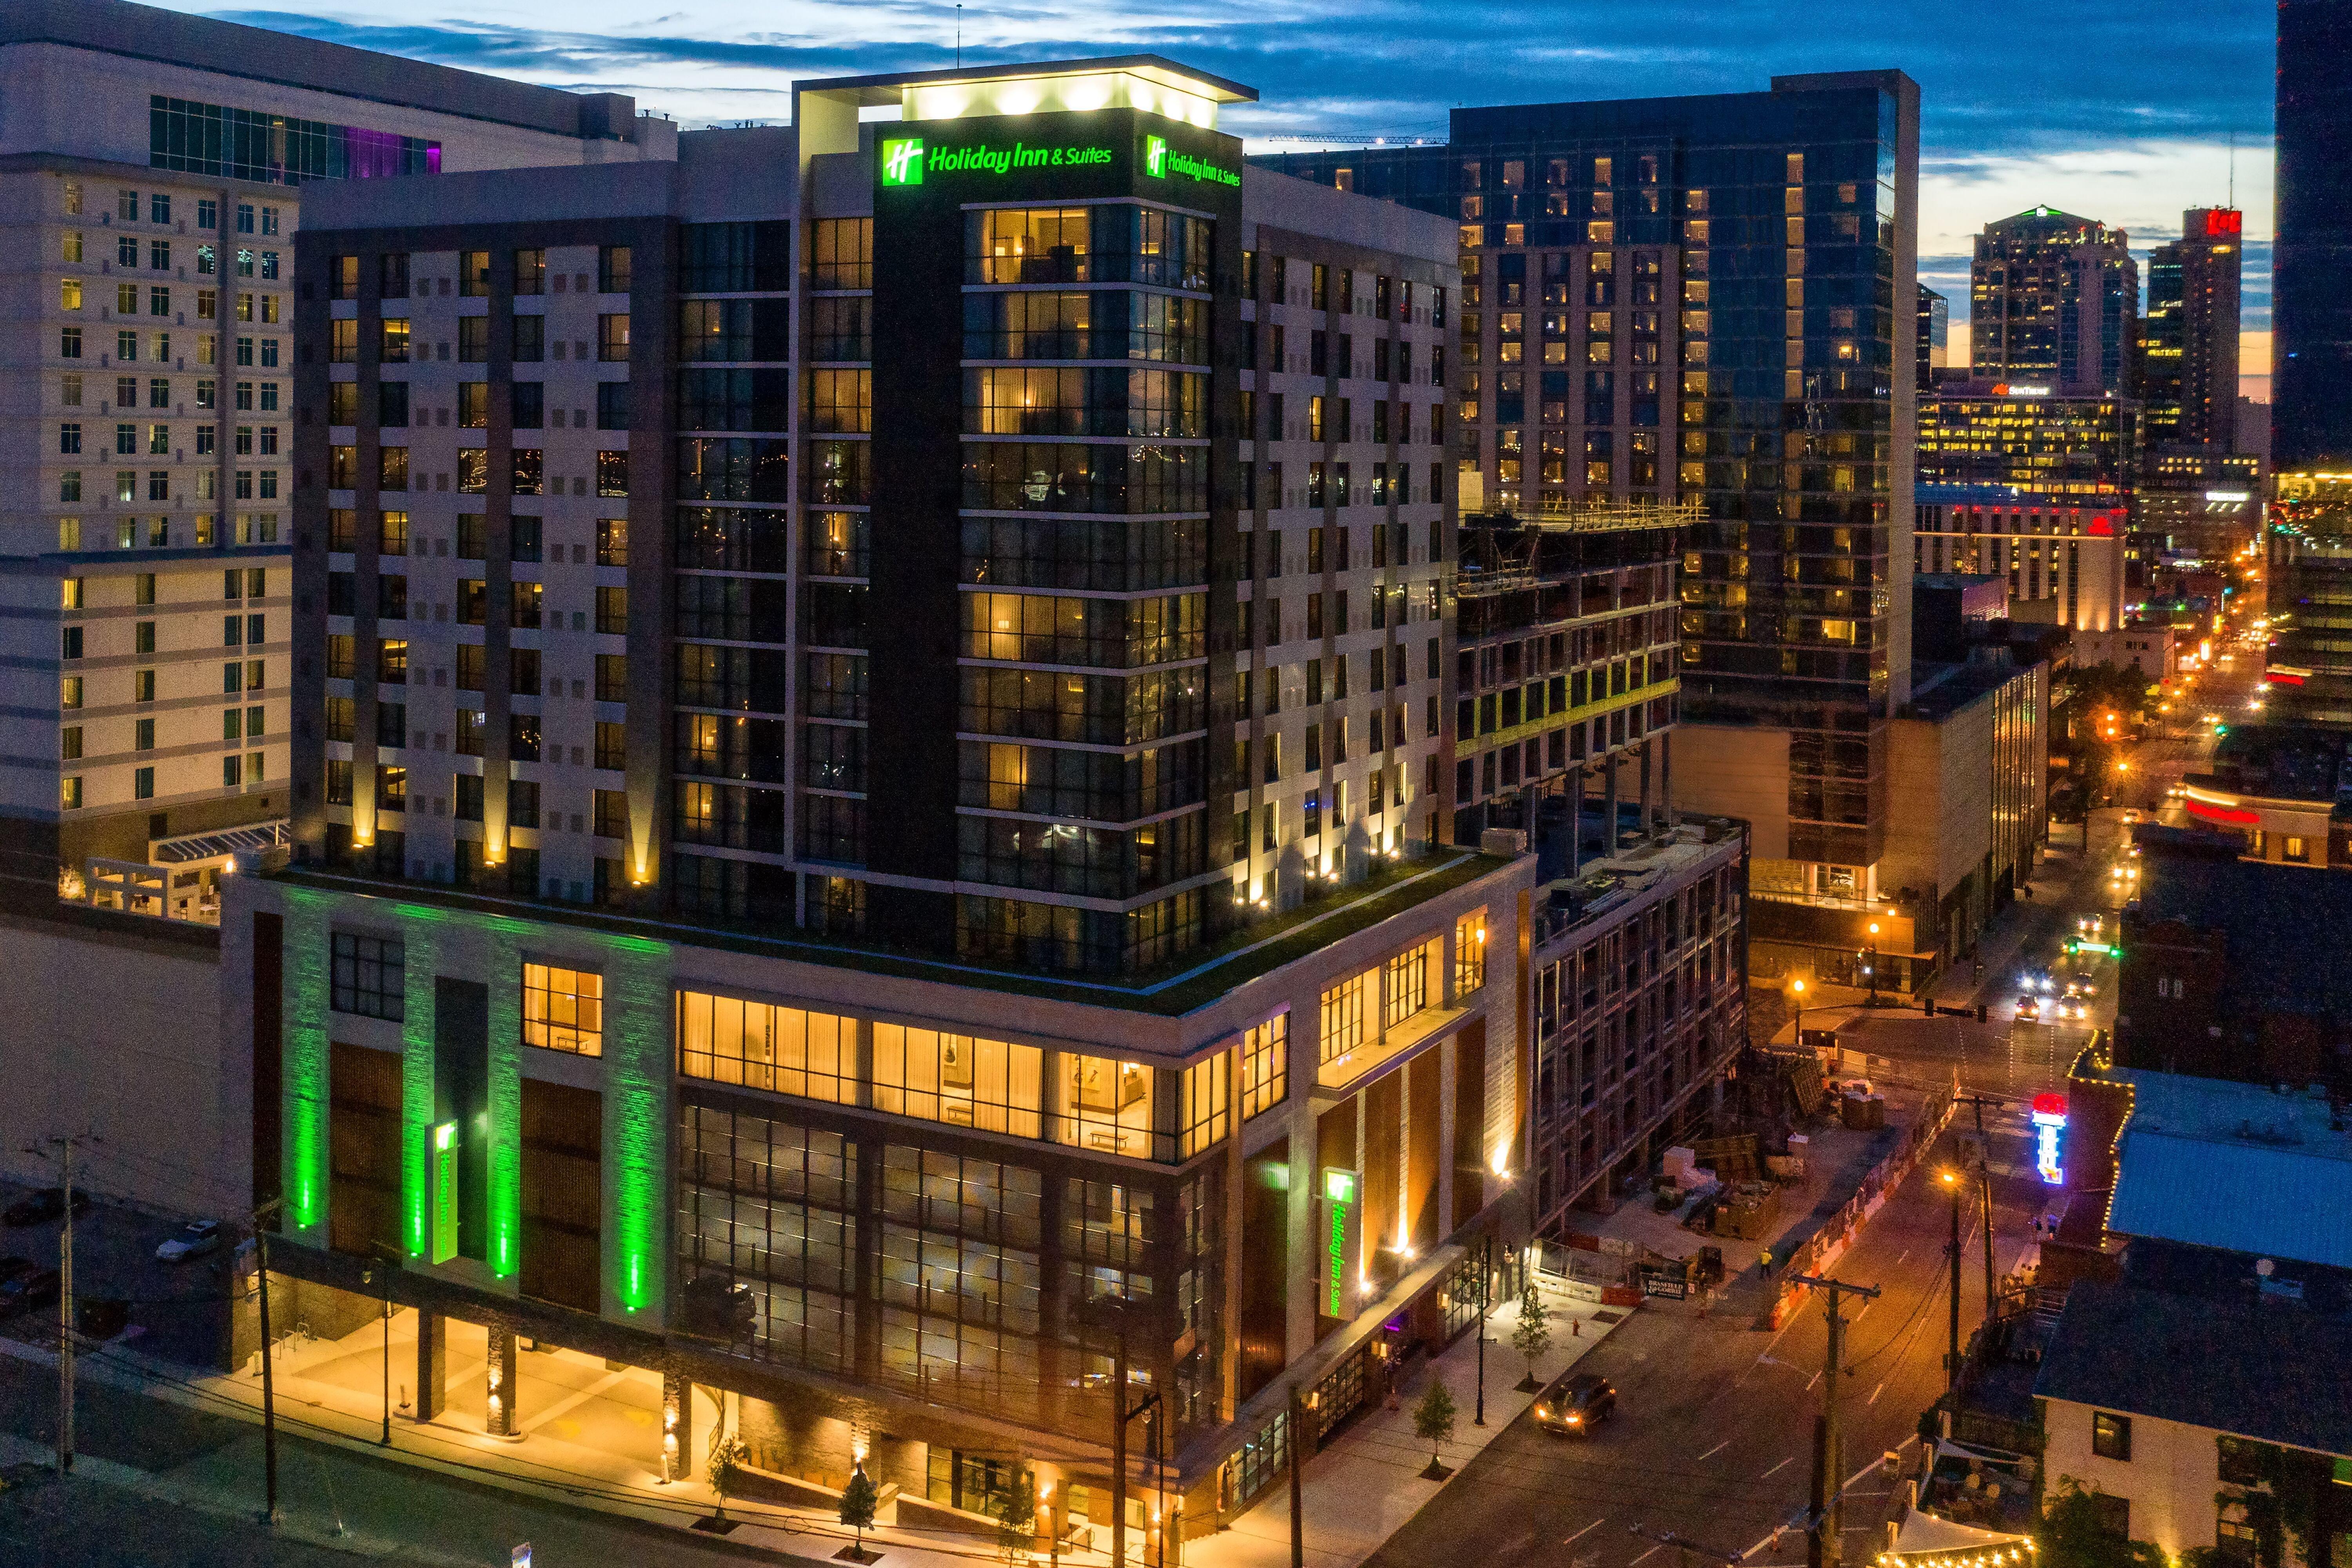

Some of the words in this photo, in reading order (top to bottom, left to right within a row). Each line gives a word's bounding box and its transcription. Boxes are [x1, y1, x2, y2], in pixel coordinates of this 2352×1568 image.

[928, 145, 1011, 174] Holiday
[1013, 142, 1048, 167] Inn
[1051, 148, 1063, 165] &
[1066, 147, 1112, 165] Suites
[1168, 150, 1202, 181] Holiday
[1202, 158, 1217, 180] Inn
[1217, 169, 1222, 182] &
[1222, 170, 1240, 186] Suites
[438, 1154, 450, 1203] Holiday
[441, 1203, 450, 1225] Inn
[1329, 1203, 1346, 1257] Holiday
[1332, 1256, 1345, 1279] Inn
[1331, 1280, 1340, 1288] &
[1330, 1289, 1340, 1317] Suites
